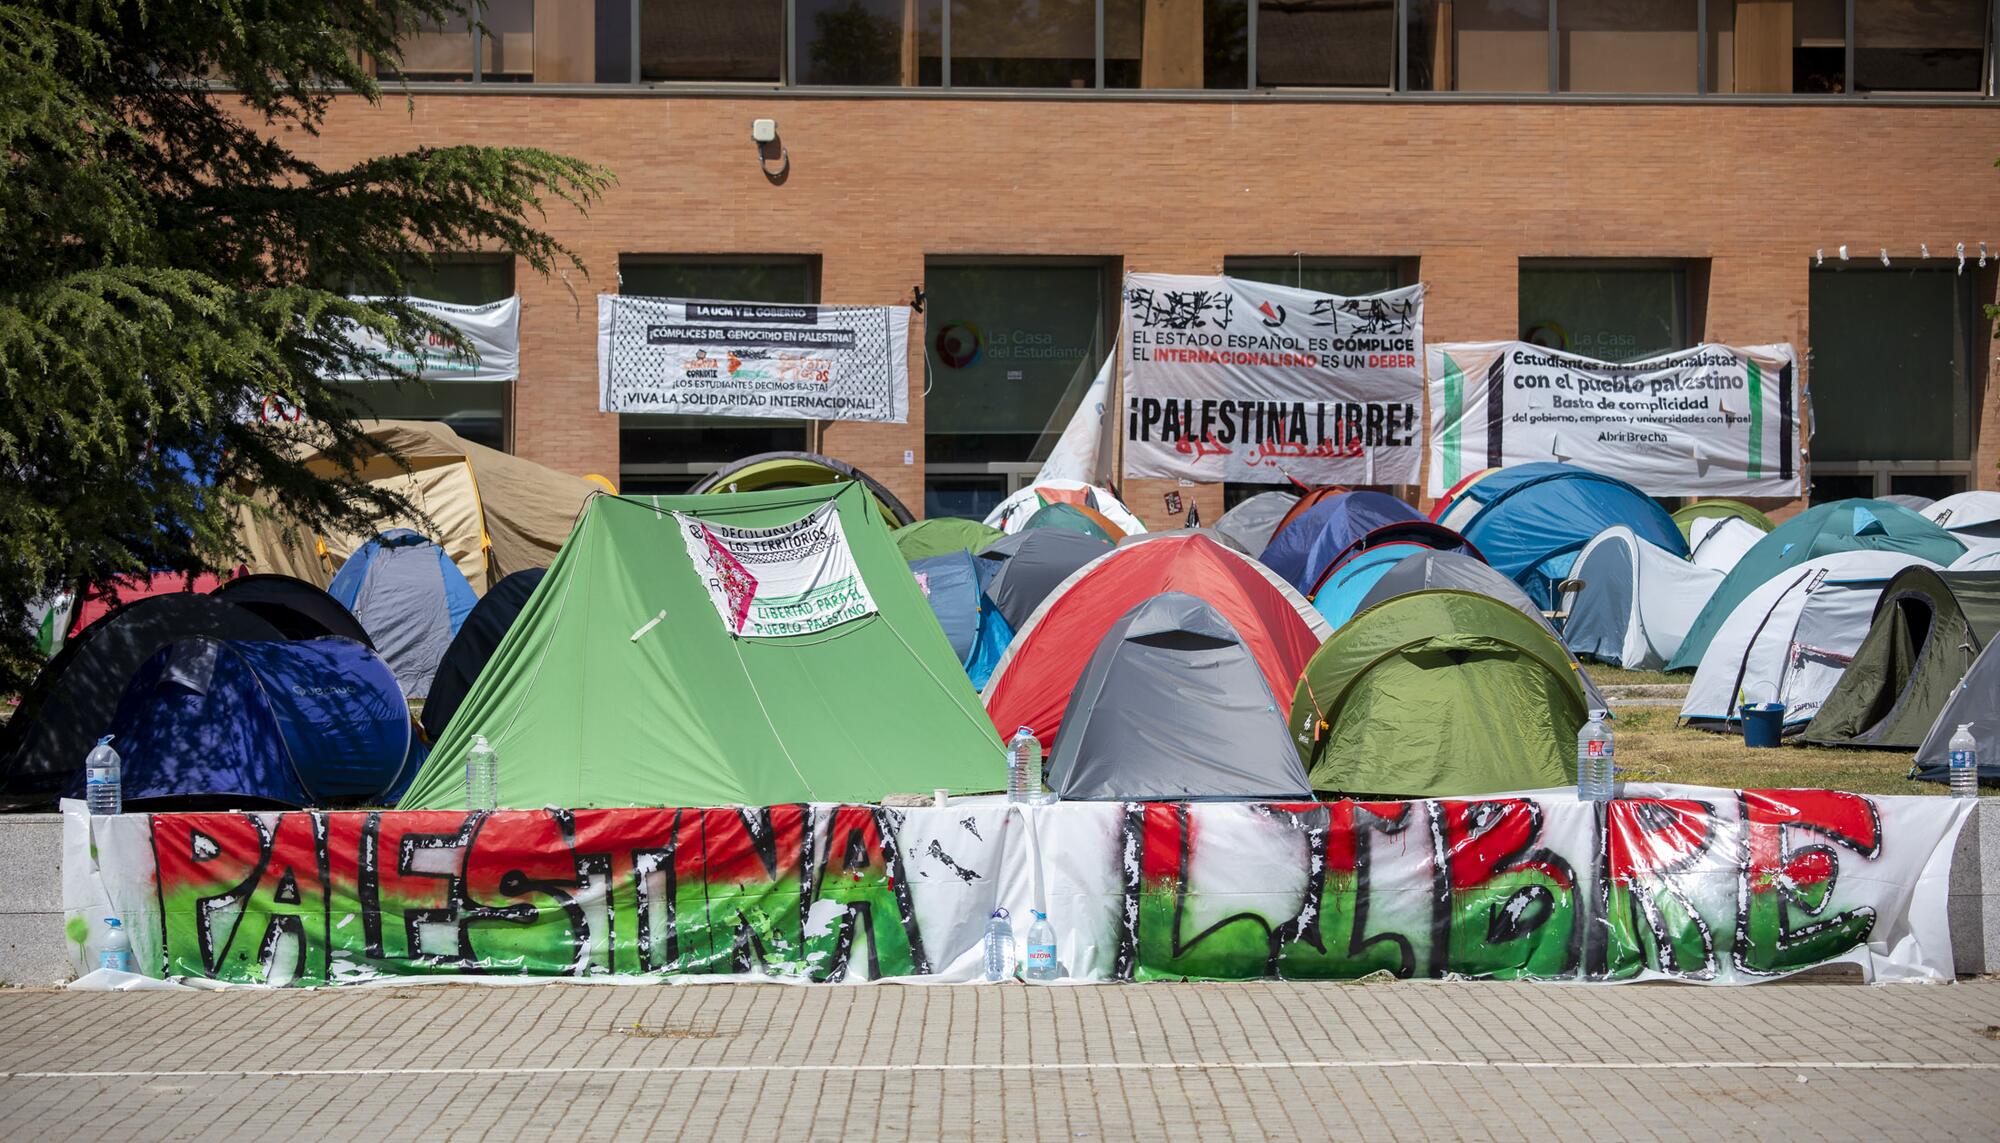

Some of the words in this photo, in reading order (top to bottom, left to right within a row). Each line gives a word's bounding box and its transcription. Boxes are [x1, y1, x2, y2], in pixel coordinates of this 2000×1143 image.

[697, 306, 710, 315] LA
[711, 306, 733, 316] UCM
[735, 307, 741, 316] Y
[743, 307, 755, 317] EL
[756, 307, 806, 318] GOBIERNO
[649, 326, 707, 340] ¡CÓMPLICES
[709, 329, 726, 339] DEL
[727, 330, 782, 341] GENOCIDIO
[784, 331, 797, 341] EN
[799, 333, 852, 343] PALESTINA!
[989, 330, 1007, 344] La
[1012, 329, 1053, 344] Casa
[1133, 330, 1151, 344] EL
[1156, 332, 1222, 347] ESTADO
[1227, 333, 1304, 351] ESPAÑOL
[1309, 338, 1328, 351] ES
[1332, 335, 1414, 352] CÓMPLICE
[1574, 331, 1591, 345] La
[1597, 331, 1636, 346] Casa
[988, 346, 1010, 358] del
[1133, 347, 1150, 361] EL
[1153, 348, 1317, 368] INTERNACIONALISMO
[1321, 354, 1339, 368] ES
[1344, 355, 1365, 369] UN
[1368, 353, 1415, 369] DEBER
[1512, 351, 1599, 371] Estudiantes
[672, 379, 693, 389] ¡LOS
[695, 380, 753, 390] ESTUDIANTES
[755, 382, 795, 390] DECIMOS
[797, 382, 828, 392] BASTA!
[1513, 374, 1550, 390] con
[1555, 374, 1573, 390] el
[1578, 374, 1645, 395] pueblo
[1650, 370, 1744, 397] palestino
[624, 392, 659, 407] ¡VIVA
[662, 393, 678, 404] LA
[681, 393, 766, 406] SOLIDARIDAD
[770, 395, 875, 409] INTERNACIONAL!
[1552, 395, 1594, 409] Basta
[1597, 397, 1616, 410] de
[1618, 396, 1709, 413] complicidad
[1129, 397, 1308, 447] ¡PALESTINA
[1317, 402, 1413, 448] LIBRE!
[1512, 413, 1528, 423] del
[1579, 415, 1627, 426] empresas
[1636, 414, 1705, 424] universidades
[1725, 414, 1751, 424] Israel
[729, 541, 750, 552] LOS
[753, 526, 828, 552] TERRITORIOS
[757, 603, 818, 620] LIBERTAD
[816, 590, 849, 612] PARA
[754, 621, 801, 635] PUEBLO
[808, 604, 866, 631] PALESTINO
[150, 803, 931, 986] PALESTINA
[1118, 788, 1882, 984] LIBRE
